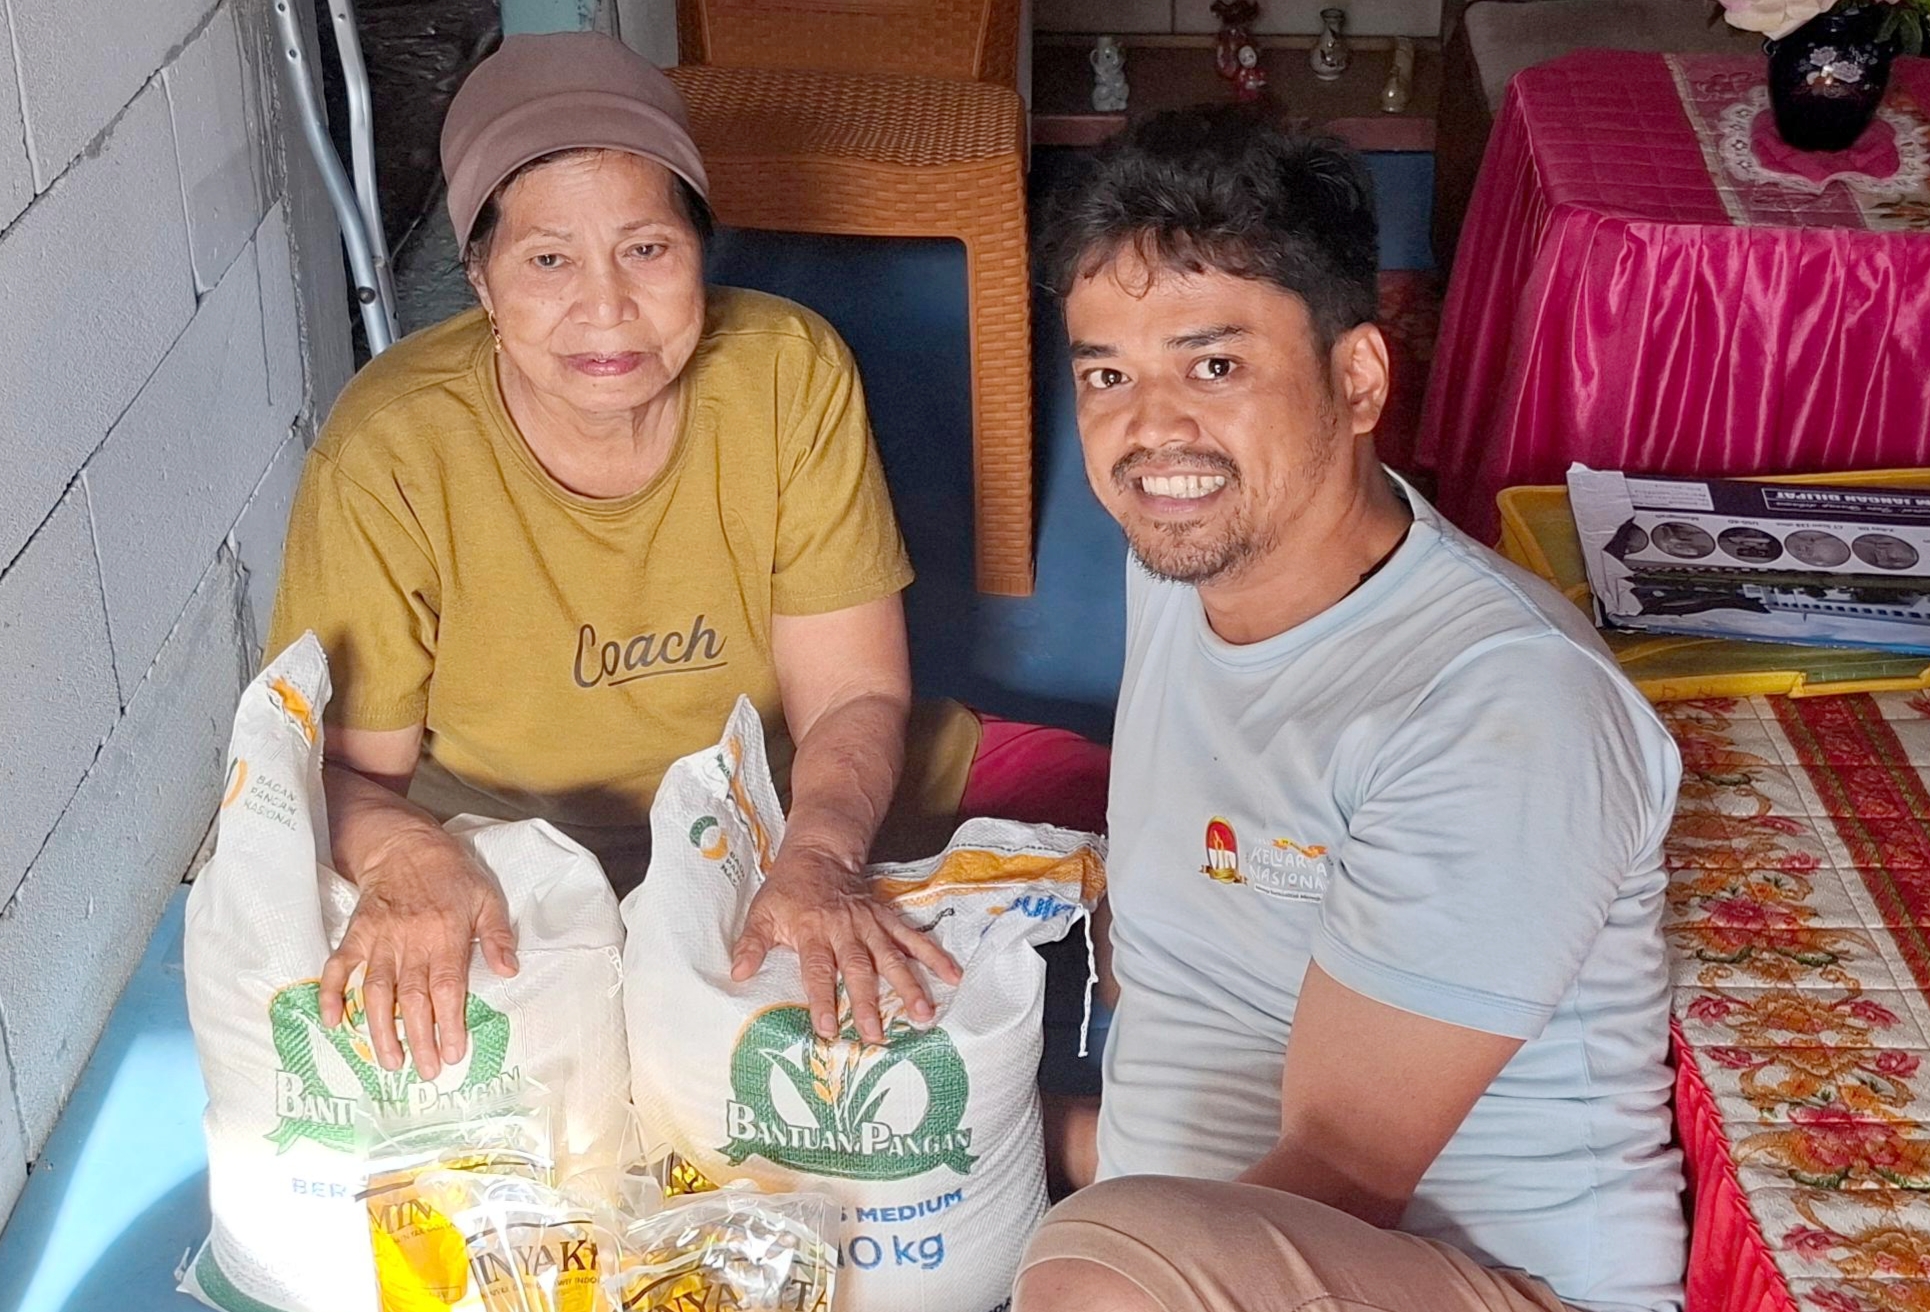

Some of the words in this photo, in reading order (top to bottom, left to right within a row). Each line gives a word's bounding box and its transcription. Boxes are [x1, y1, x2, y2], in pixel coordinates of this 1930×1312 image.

[1775, 490, 1841, 502] DILIPAT
[1844, 494, 1911, 506] JANGAN
[574, 614, 728, 688] Coach
[1250, 845, 1328, 878] KELUARA
[726, 1099, 856, 1153] BANTUAN
[861, 1120, 974, 1157] PANGAN
[292, 1177, 348, 1198] BER
[856, 1187, 963, 1223] MEDIUM
[892, 1232, 946, 1270] kg
